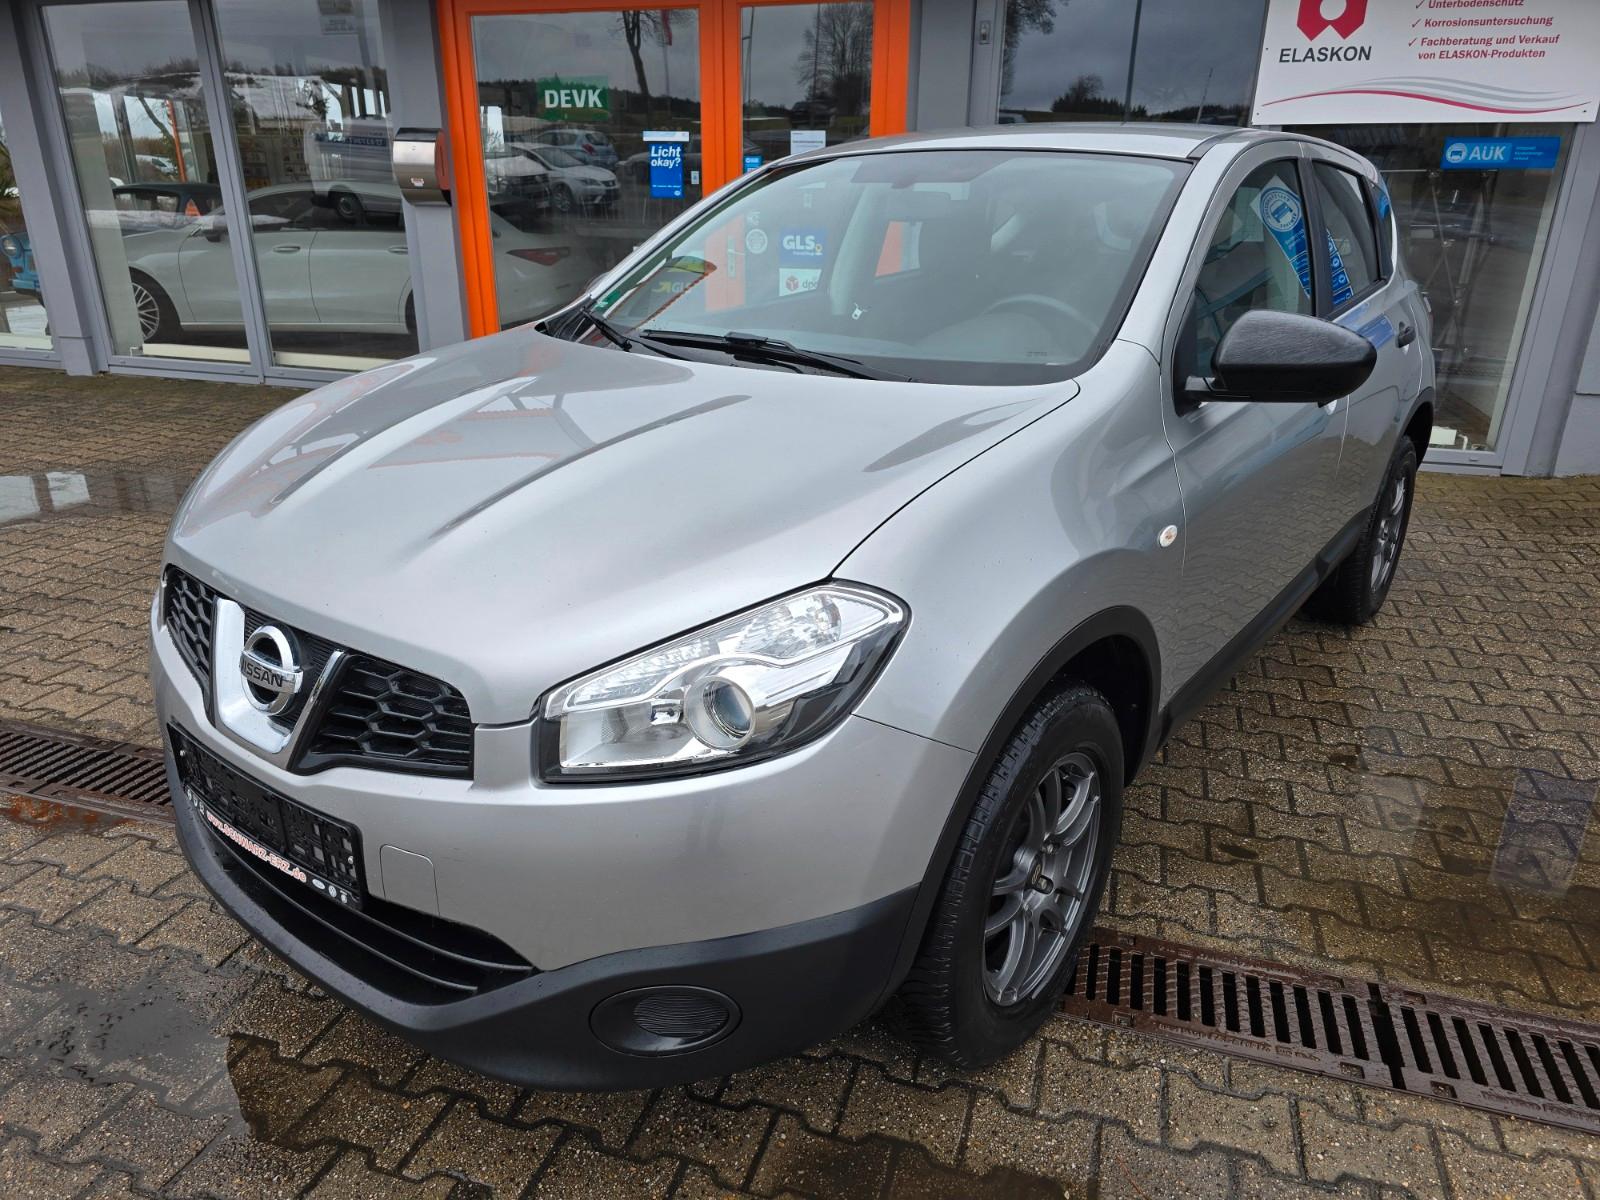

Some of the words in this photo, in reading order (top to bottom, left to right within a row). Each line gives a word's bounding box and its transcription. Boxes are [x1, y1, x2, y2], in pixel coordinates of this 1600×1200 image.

[1428, 0, 1524, 9] Unterbodenschutz
[1424, 16, 1553, 28] Korrosionsuntersuchung
[1420, 36, 1493, 47] Fachberatung
[1495, 35, 1515, 45] und
[1519, 34, 1560, 44] Verkauf
[1279, 46, 1372, 63] ELASKON
[1418, 52, 1436, 60] von
[1438, 49, 1546, 60] ELASKON-Produkten
[544, 88, 603, 109] DEVK
[650, 145, 681, 157] Licht
[650, 157, 681, 169] okay?
[782, 234, 816, 251] GLS
[241, 656, 283, 687] NISSAN
